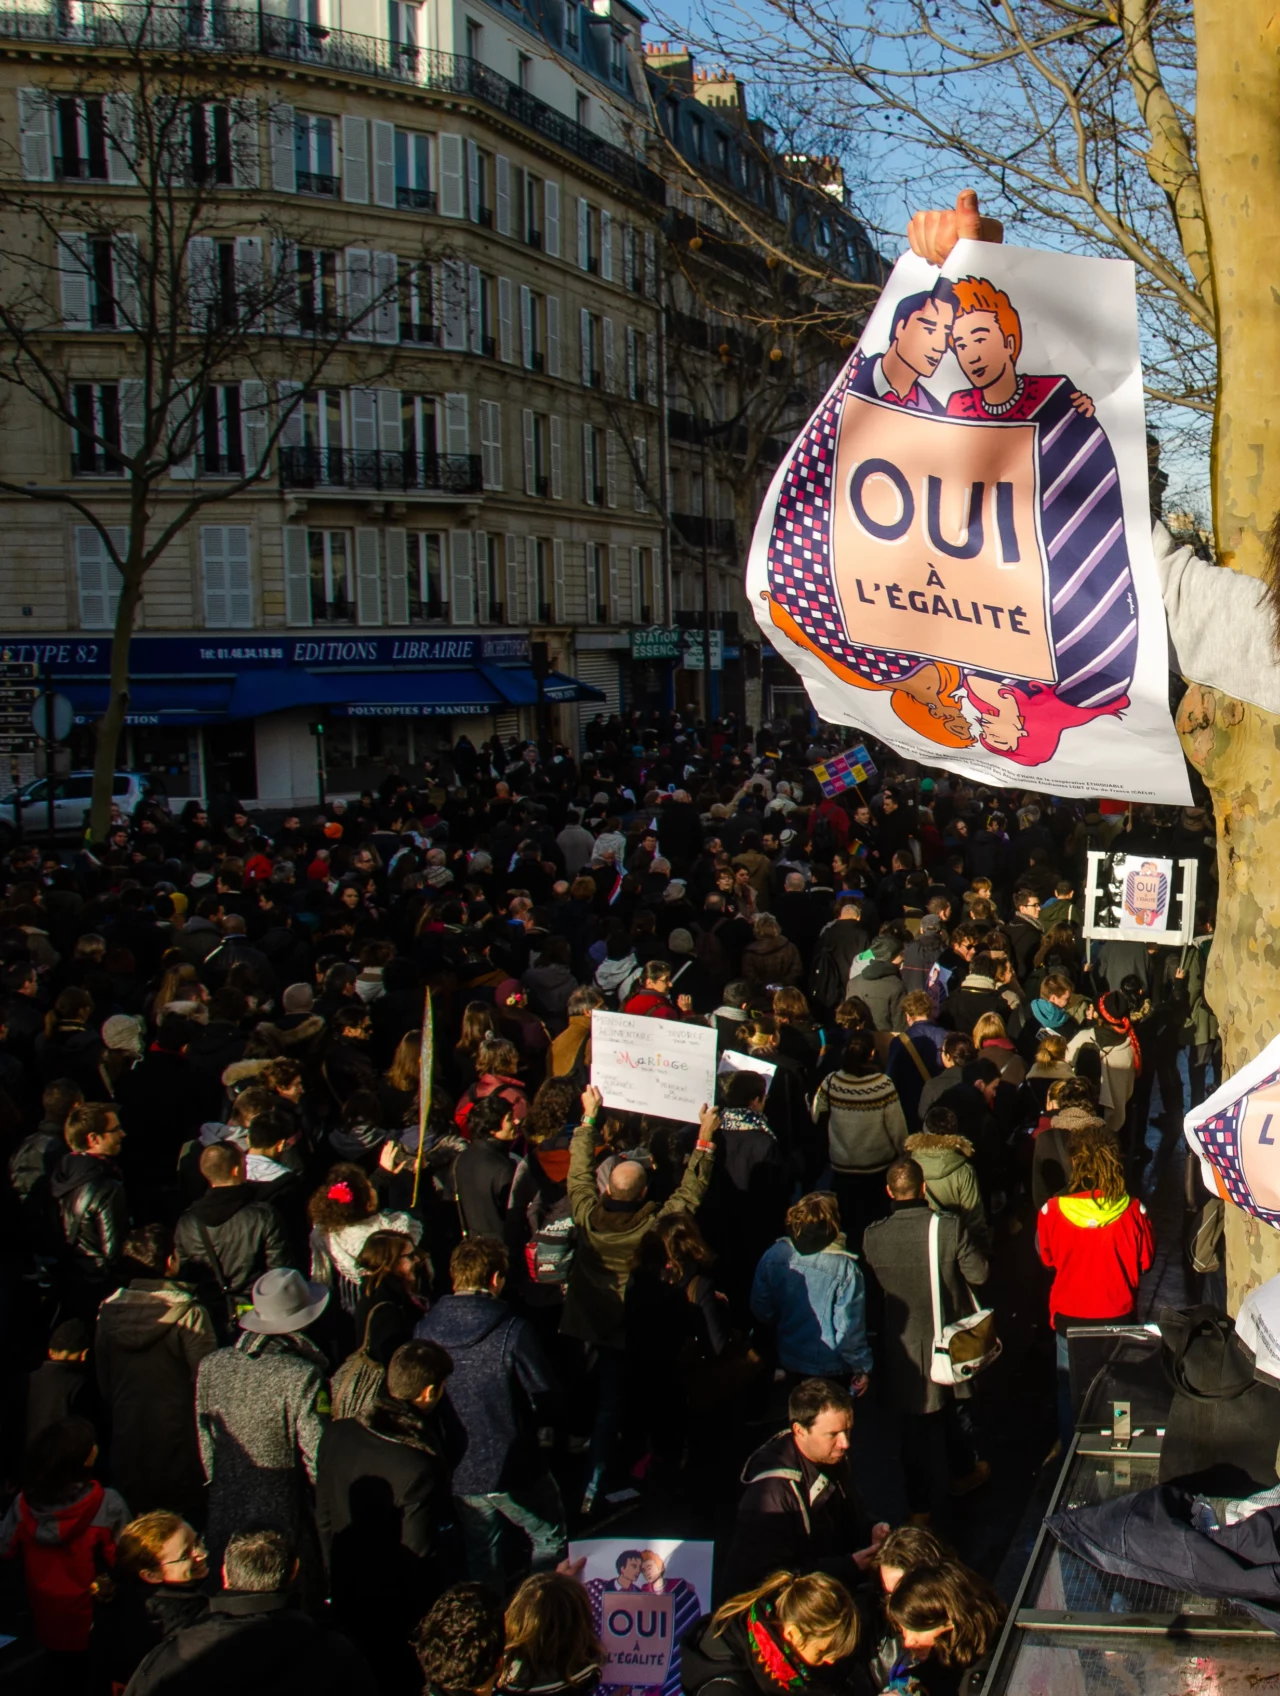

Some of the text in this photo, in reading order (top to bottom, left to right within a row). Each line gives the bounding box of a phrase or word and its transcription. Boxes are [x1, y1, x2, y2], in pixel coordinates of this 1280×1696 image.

[847, 458, 1021, 566] OUI
[926, 562, 946, 589] À
[855, 578, 1031, 635] L'ÉGALITÉ
[75, 645, 99, 663] 82
[293, 640, 474, 661] EDITIONS LIBRAIRIE
[346, 705, 420, 717] POLYCOPIES
[434, 704, 490, 715] MANUELS
[1135, 881, 1157, 894] OUI
[607, 1609, 667, 1639] OUI
[632, 1639, 641, 1651] À
[606, 1651, 665, 1666] L'ÉGALITÉ
